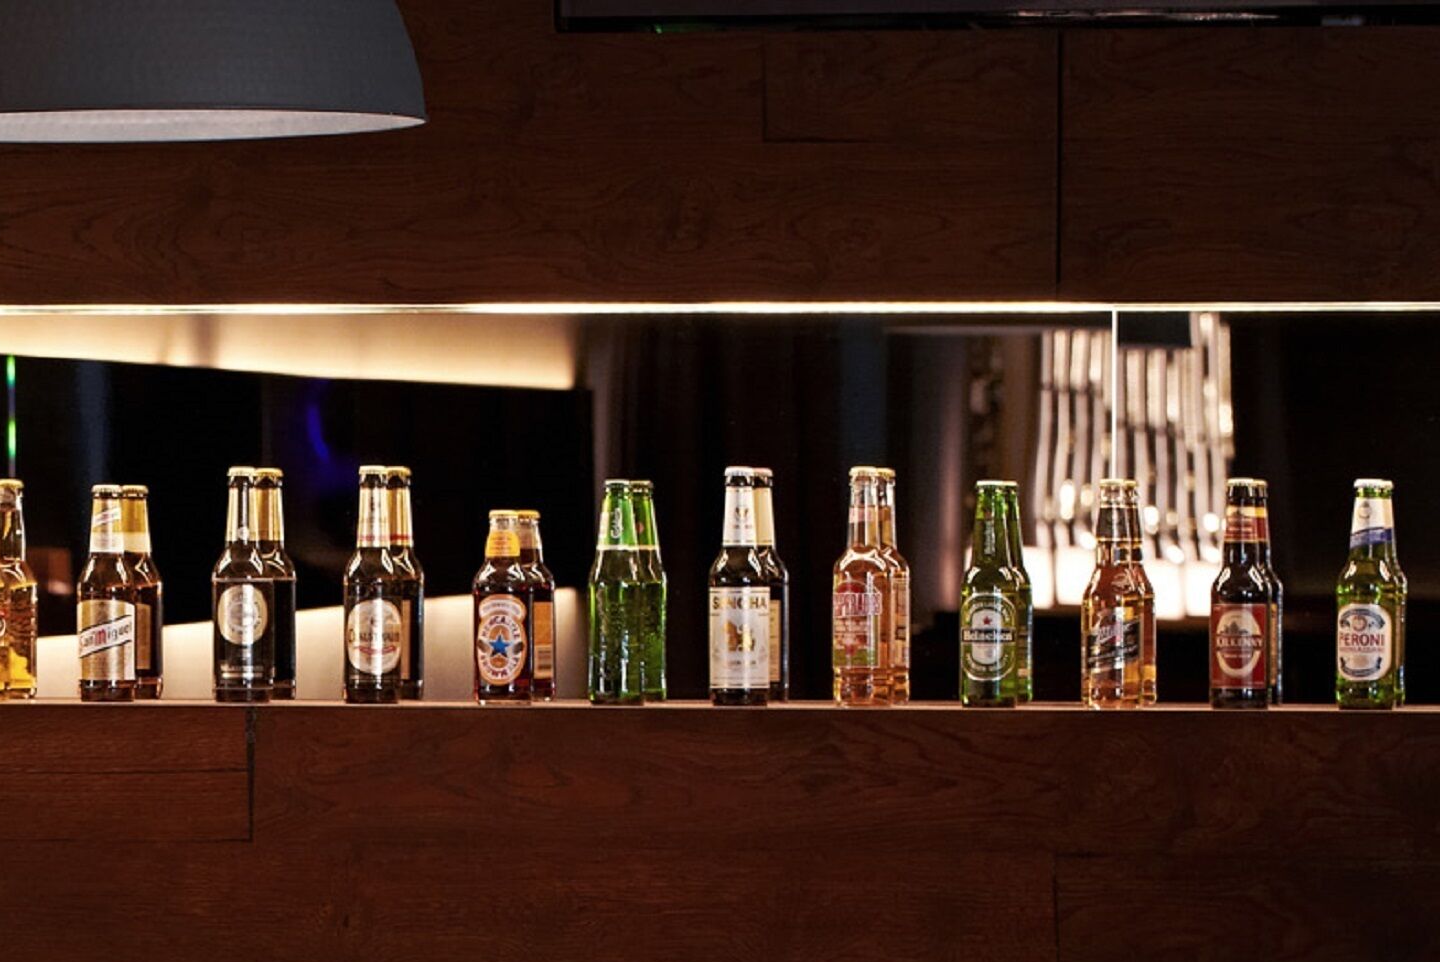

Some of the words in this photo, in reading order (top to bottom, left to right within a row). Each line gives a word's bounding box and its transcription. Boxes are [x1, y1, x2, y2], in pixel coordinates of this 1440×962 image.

[712, 596, 768, 610] SNGHA
[963, 630, 1013, 641] Heineken
[1339, 633, 1385, 647] PERONI
